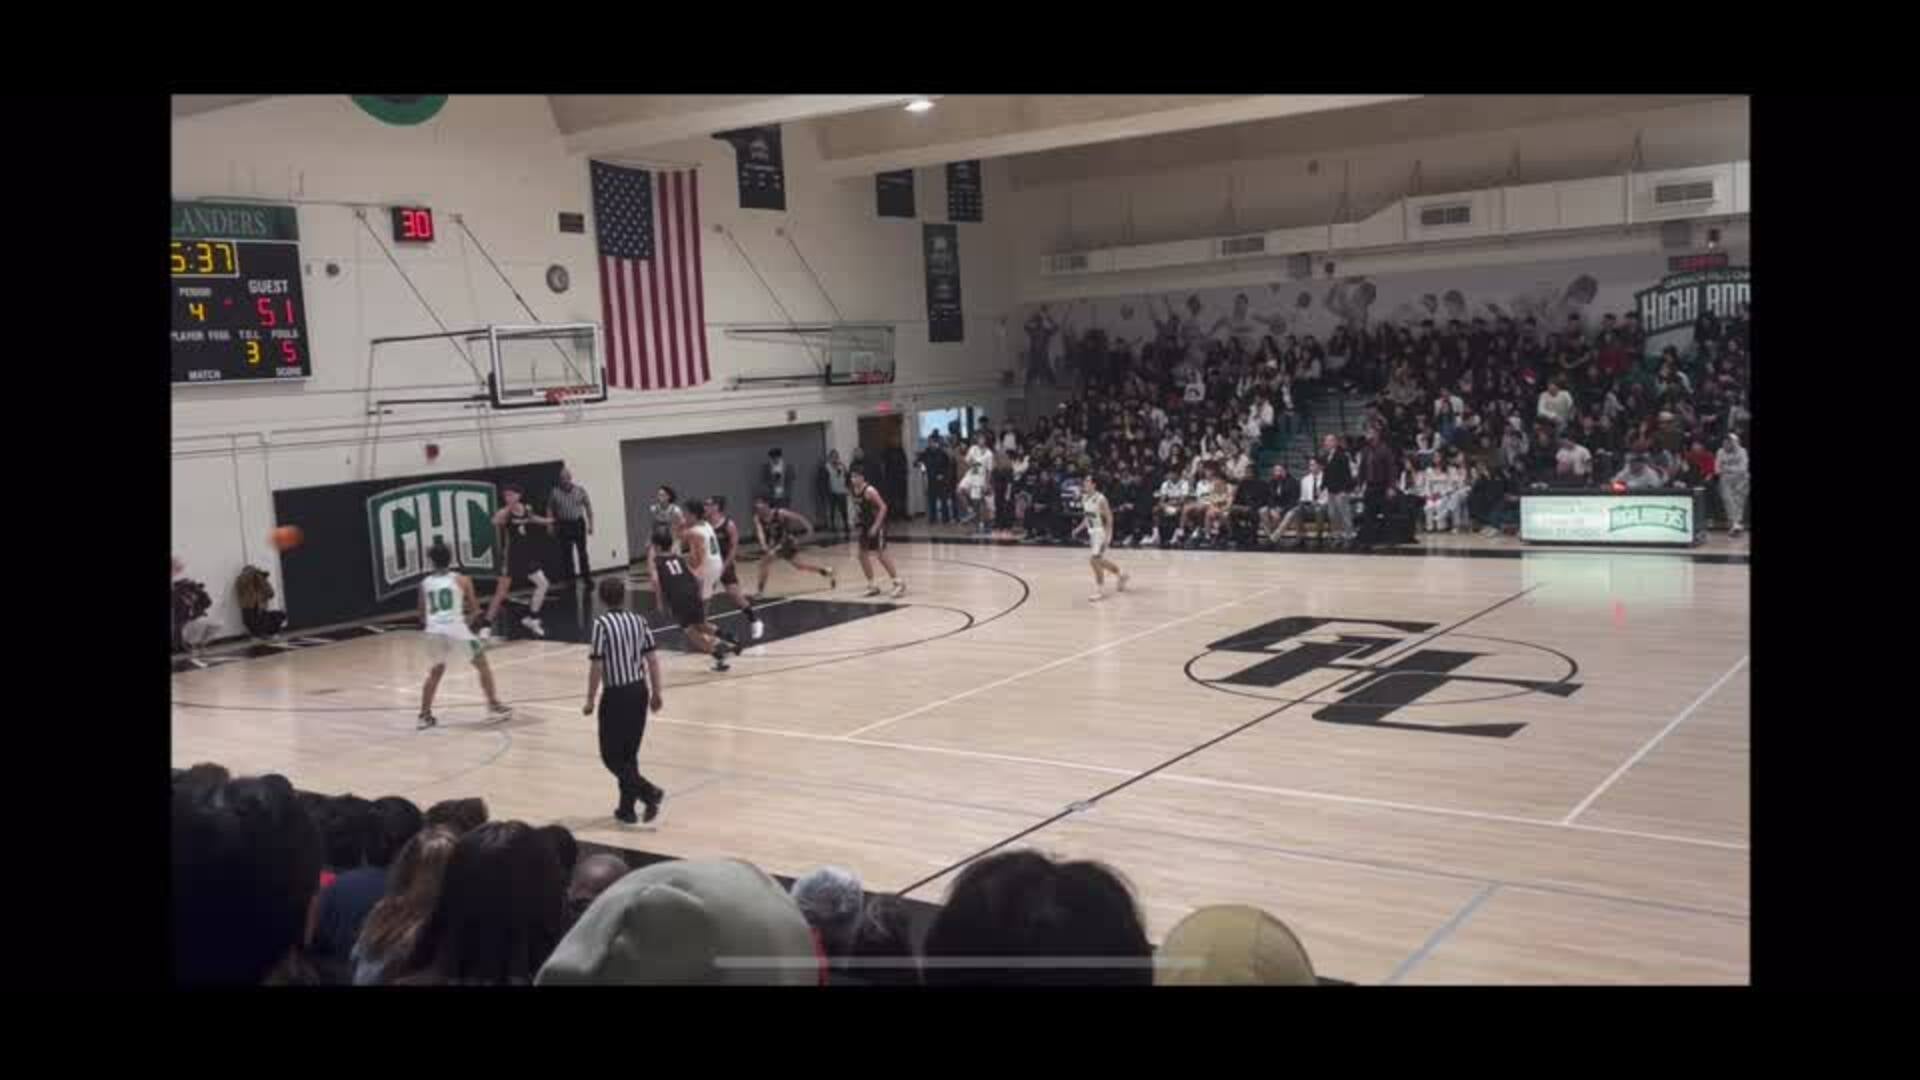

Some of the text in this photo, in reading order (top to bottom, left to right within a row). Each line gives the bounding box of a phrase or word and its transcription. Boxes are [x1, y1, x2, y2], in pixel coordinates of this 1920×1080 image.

[402, 209, 431, 238] 30
[171, 243, 234, 273] 5:37
[179, 287, 212, 297] PERIOD
[247, 279, 288, 294] GUEST
[188, 303, 206, 321] 4
[257, 297, 297, 327] 51
[246, 341, 261, 364] 3
[281, 340, 298, 363] 5
[188, 370, 221, 380] MATCH
[276, 367, 302, 376] SCORE
[379, 490, 494, 585] GHC
[665, 559, 683, 576] 11
[428, 587, 455, 614] 10
